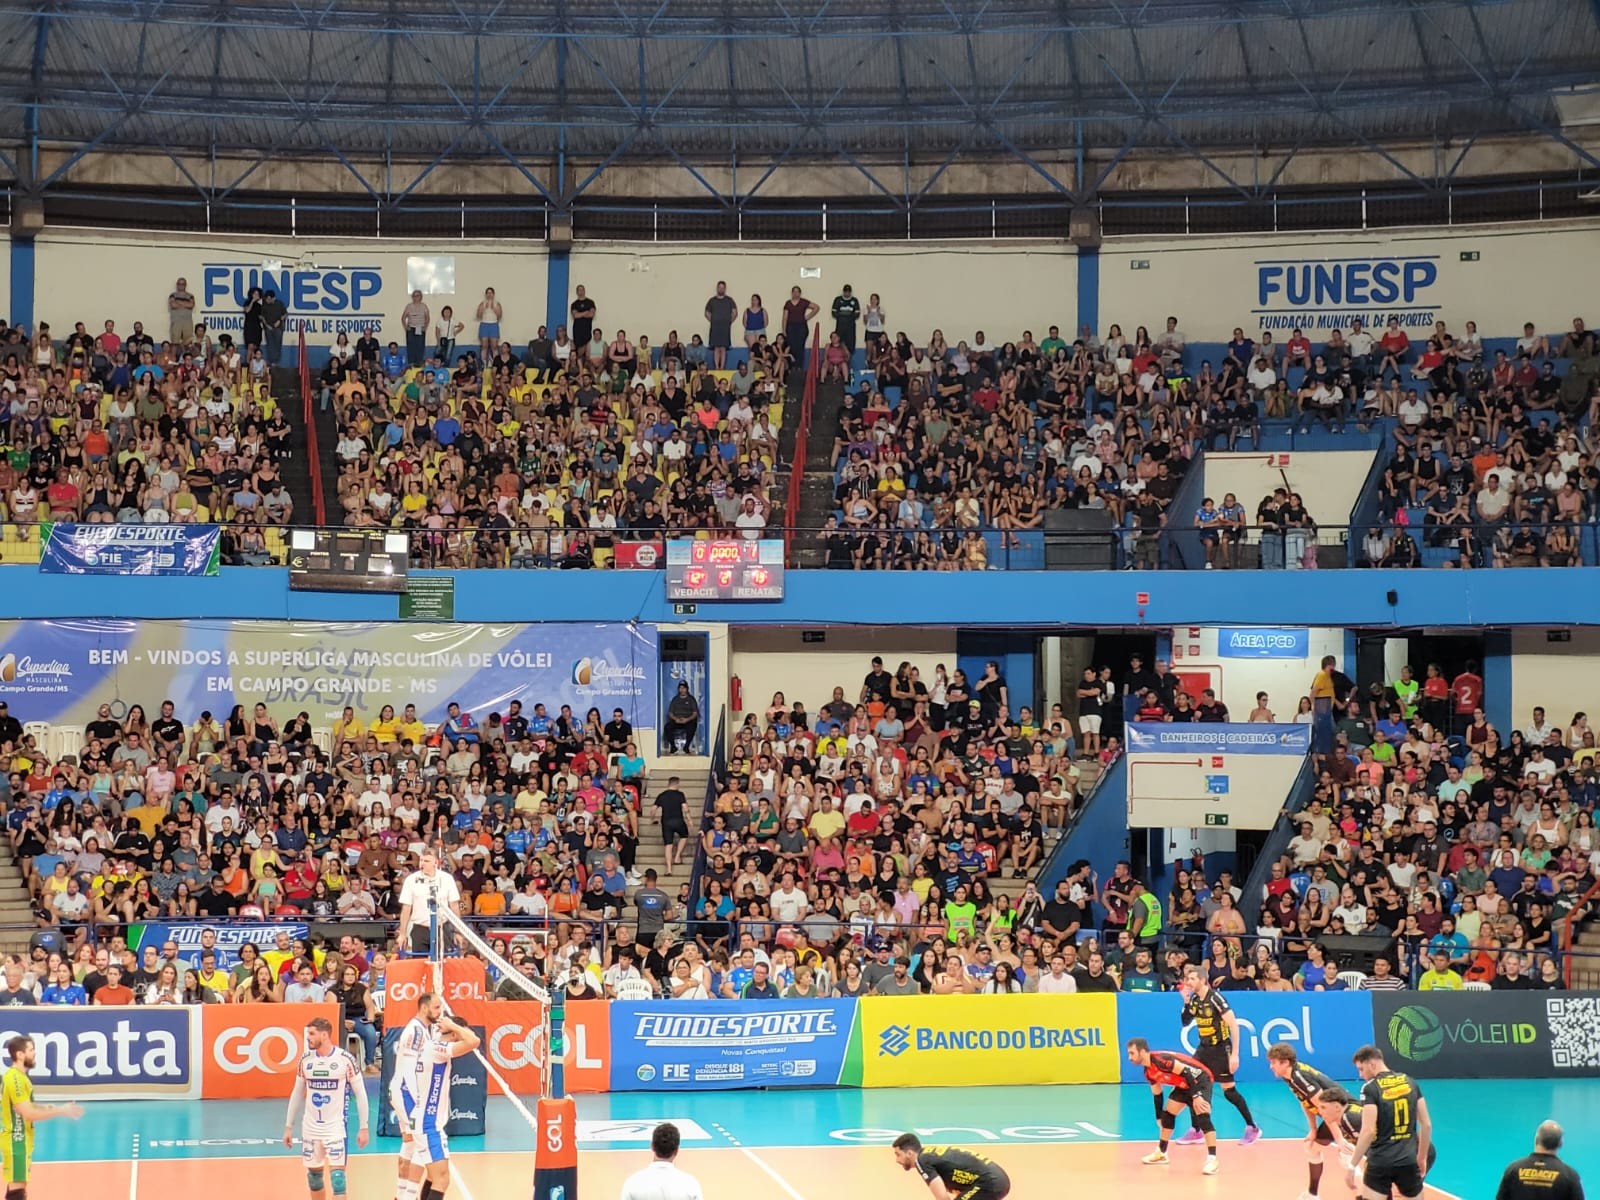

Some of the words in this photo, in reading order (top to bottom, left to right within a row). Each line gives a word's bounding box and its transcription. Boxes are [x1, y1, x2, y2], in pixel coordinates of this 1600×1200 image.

[204, 267, 382, 311] FUNESP
[1258, 261, 1437, 306] FUNESP
[203, 316, 245, 333] FUNDAÇ
[322, 319, 333, 333] DE
[1259, 312, 1314, 329] FUNDAÇÃO
[1373, 314, 1385, 328] DE
[1230, 632, 1266, 648] ÁREA
[1267, 634, 1296, 648] PCD
[17, 656, 73, 678] Superliga
[88, 649, 129, 665] BEM
[147, 649, 222, 666] VINDOS
[227, 650, 240, 666] A
[245, 650, 348, 667] SUPERLIGA
[353, 651, 463, 668] MASCULINA
[469, 652, 492, 668] DE
[497, 649, 552, 668] VÔLEI
[207, 676, 233, 692] EM
[239, 676, 309, 693] CAMPO
[314, 676, 392, 694] GRANDE
[410, 678, 438, 694] MS
[1461, 686, 1472, 704] 2
[1160, 732, 1218, 744] BANHEIROS
[1226, 732, 1276, 744] CADEIRAS
[168, 927, 297, 944] FUNESPOR
[636, 1013, 833, 1037] FUNDESPORTE
[1445, 1018, 1508, 1044] VÔLEI
[1511, 1023, 1537, 1044] ID
[489, 1023, 602, 1070] GOL
[916, 1027, 993, 1051] BANCO
[997, 1030, 1026, 1050] DO
[1029, 1025, 1106, 1049] BRASIL
[663, 1064, 690, 1078] FIE
[728, 1063, 745, 1073] 181
[546, 1114, 563, 1152] GOL
[829, 1121, 1122, 1142] enel
[1518, 1168, 1560, 1180] VEDACIT
